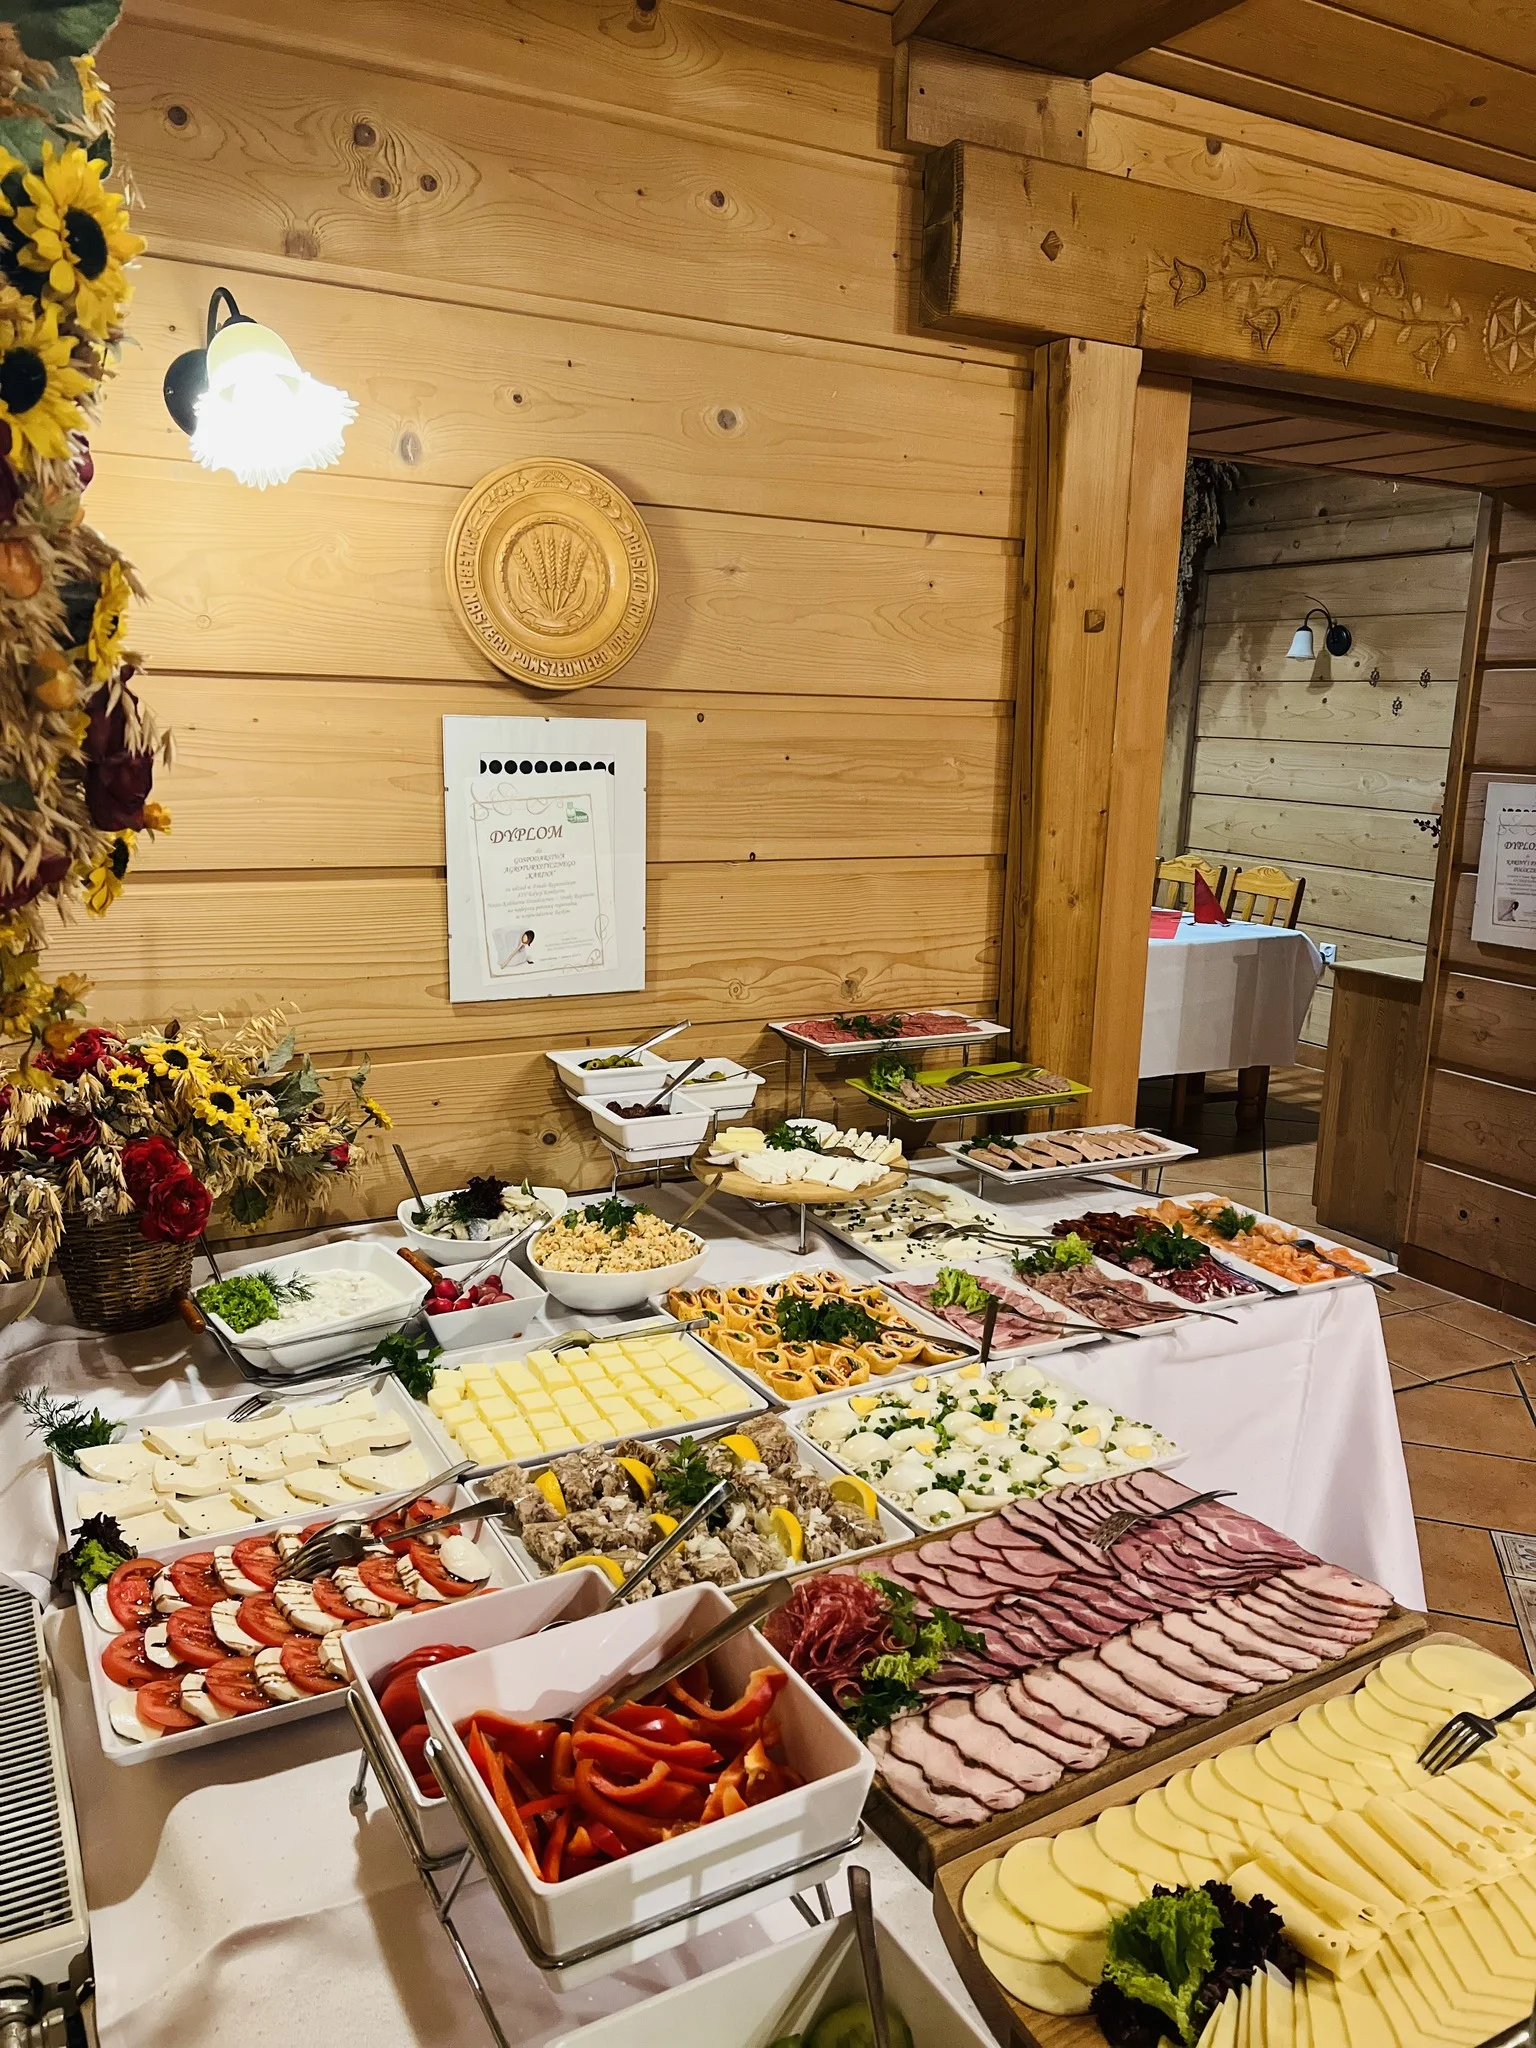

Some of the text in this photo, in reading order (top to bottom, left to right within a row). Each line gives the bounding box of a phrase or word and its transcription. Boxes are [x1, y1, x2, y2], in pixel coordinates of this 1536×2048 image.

[622, 531, 648, 593] DZISIAJ
[463, 592, 511, 655] NASZEGO
[624, 596, 648, 628] NAM
[606, 626, 635, 656] DAJ
[511, 648, 612, 677] POWSZEDNIEGO
[490, 825, 563, 843] DYPLOM
[1504, 841, 1536, 851] DYPLO
[504, 861, 576, 874] AGROTURYSTYCZNEGO
[514, 853, 565, 865] GOSPODARSTWA
